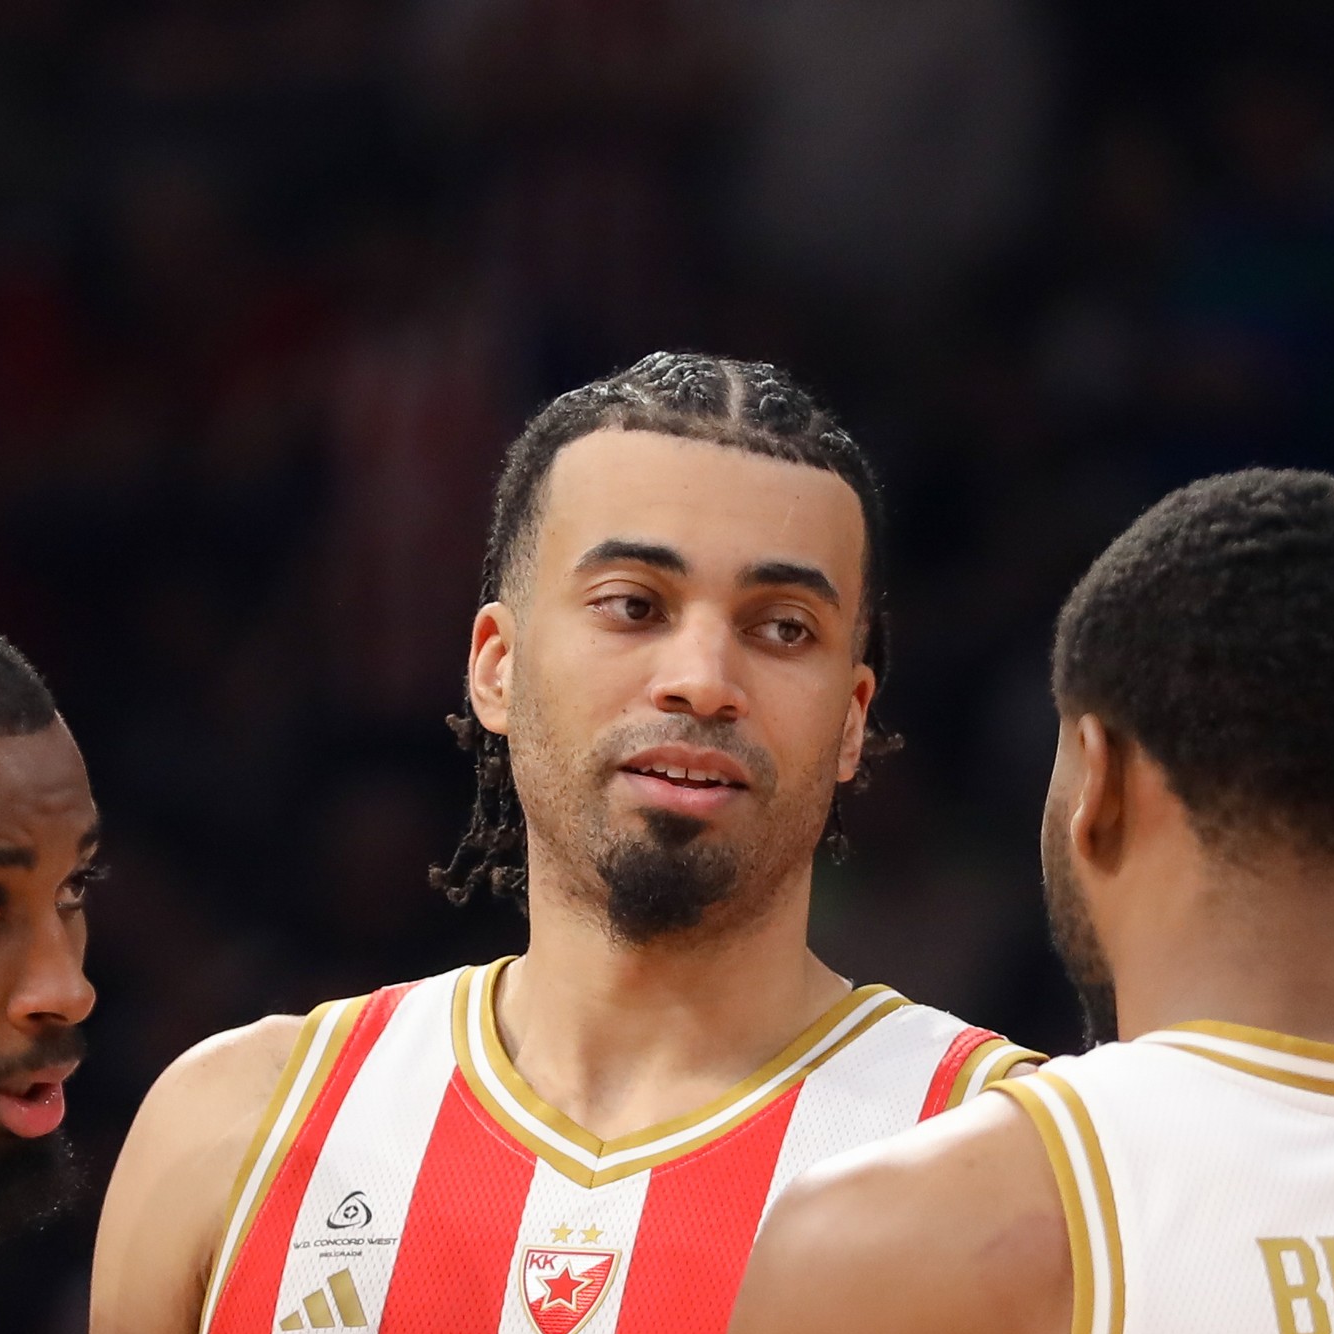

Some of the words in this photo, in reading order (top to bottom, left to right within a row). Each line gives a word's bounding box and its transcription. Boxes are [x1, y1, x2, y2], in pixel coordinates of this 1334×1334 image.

[314, 1238, 365, 1248] CONCORD
[367, 1237, 398, 1246] WEST
[319, 1250, 363, 1259] BELGRADE
[528, 1253, 558, 1271] KK
